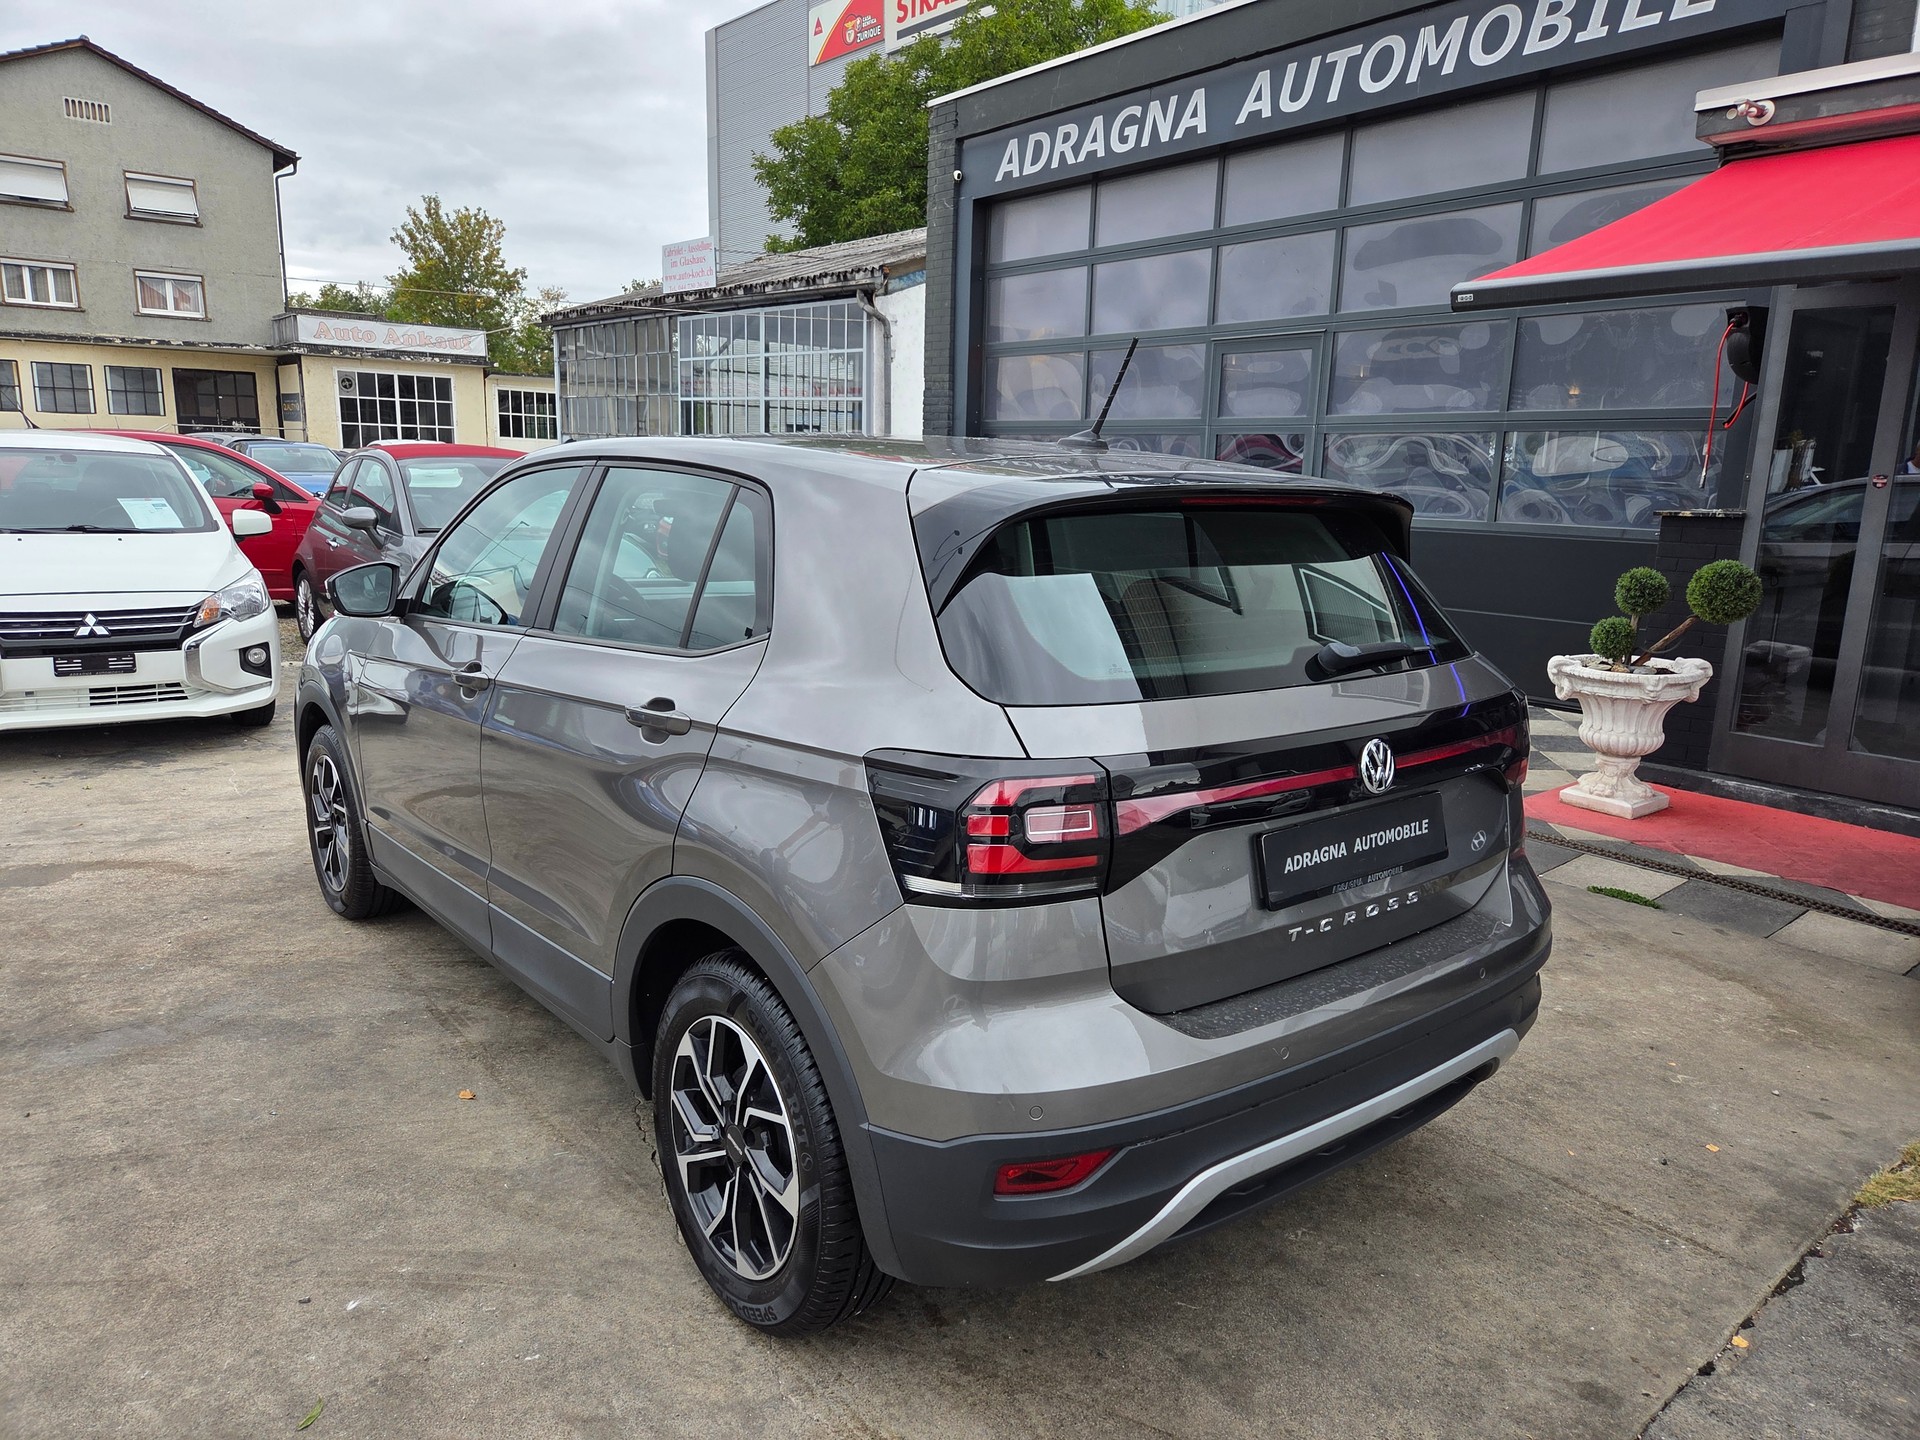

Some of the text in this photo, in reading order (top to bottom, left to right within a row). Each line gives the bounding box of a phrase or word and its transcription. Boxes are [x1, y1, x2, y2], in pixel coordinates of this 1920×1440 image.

[856, 25, 881, 43] ZURIQUE
[995, 88, 1207, 182] ADRAGNA
[670, 255, 706, 268] im Glashaus
[313, 321, 472, 351] Auto Ankauf
[1284, 819, 1429, 874] ADRAGNA AUTOMOBILE
[1288, 890, 1420, 943] T-CROSS
